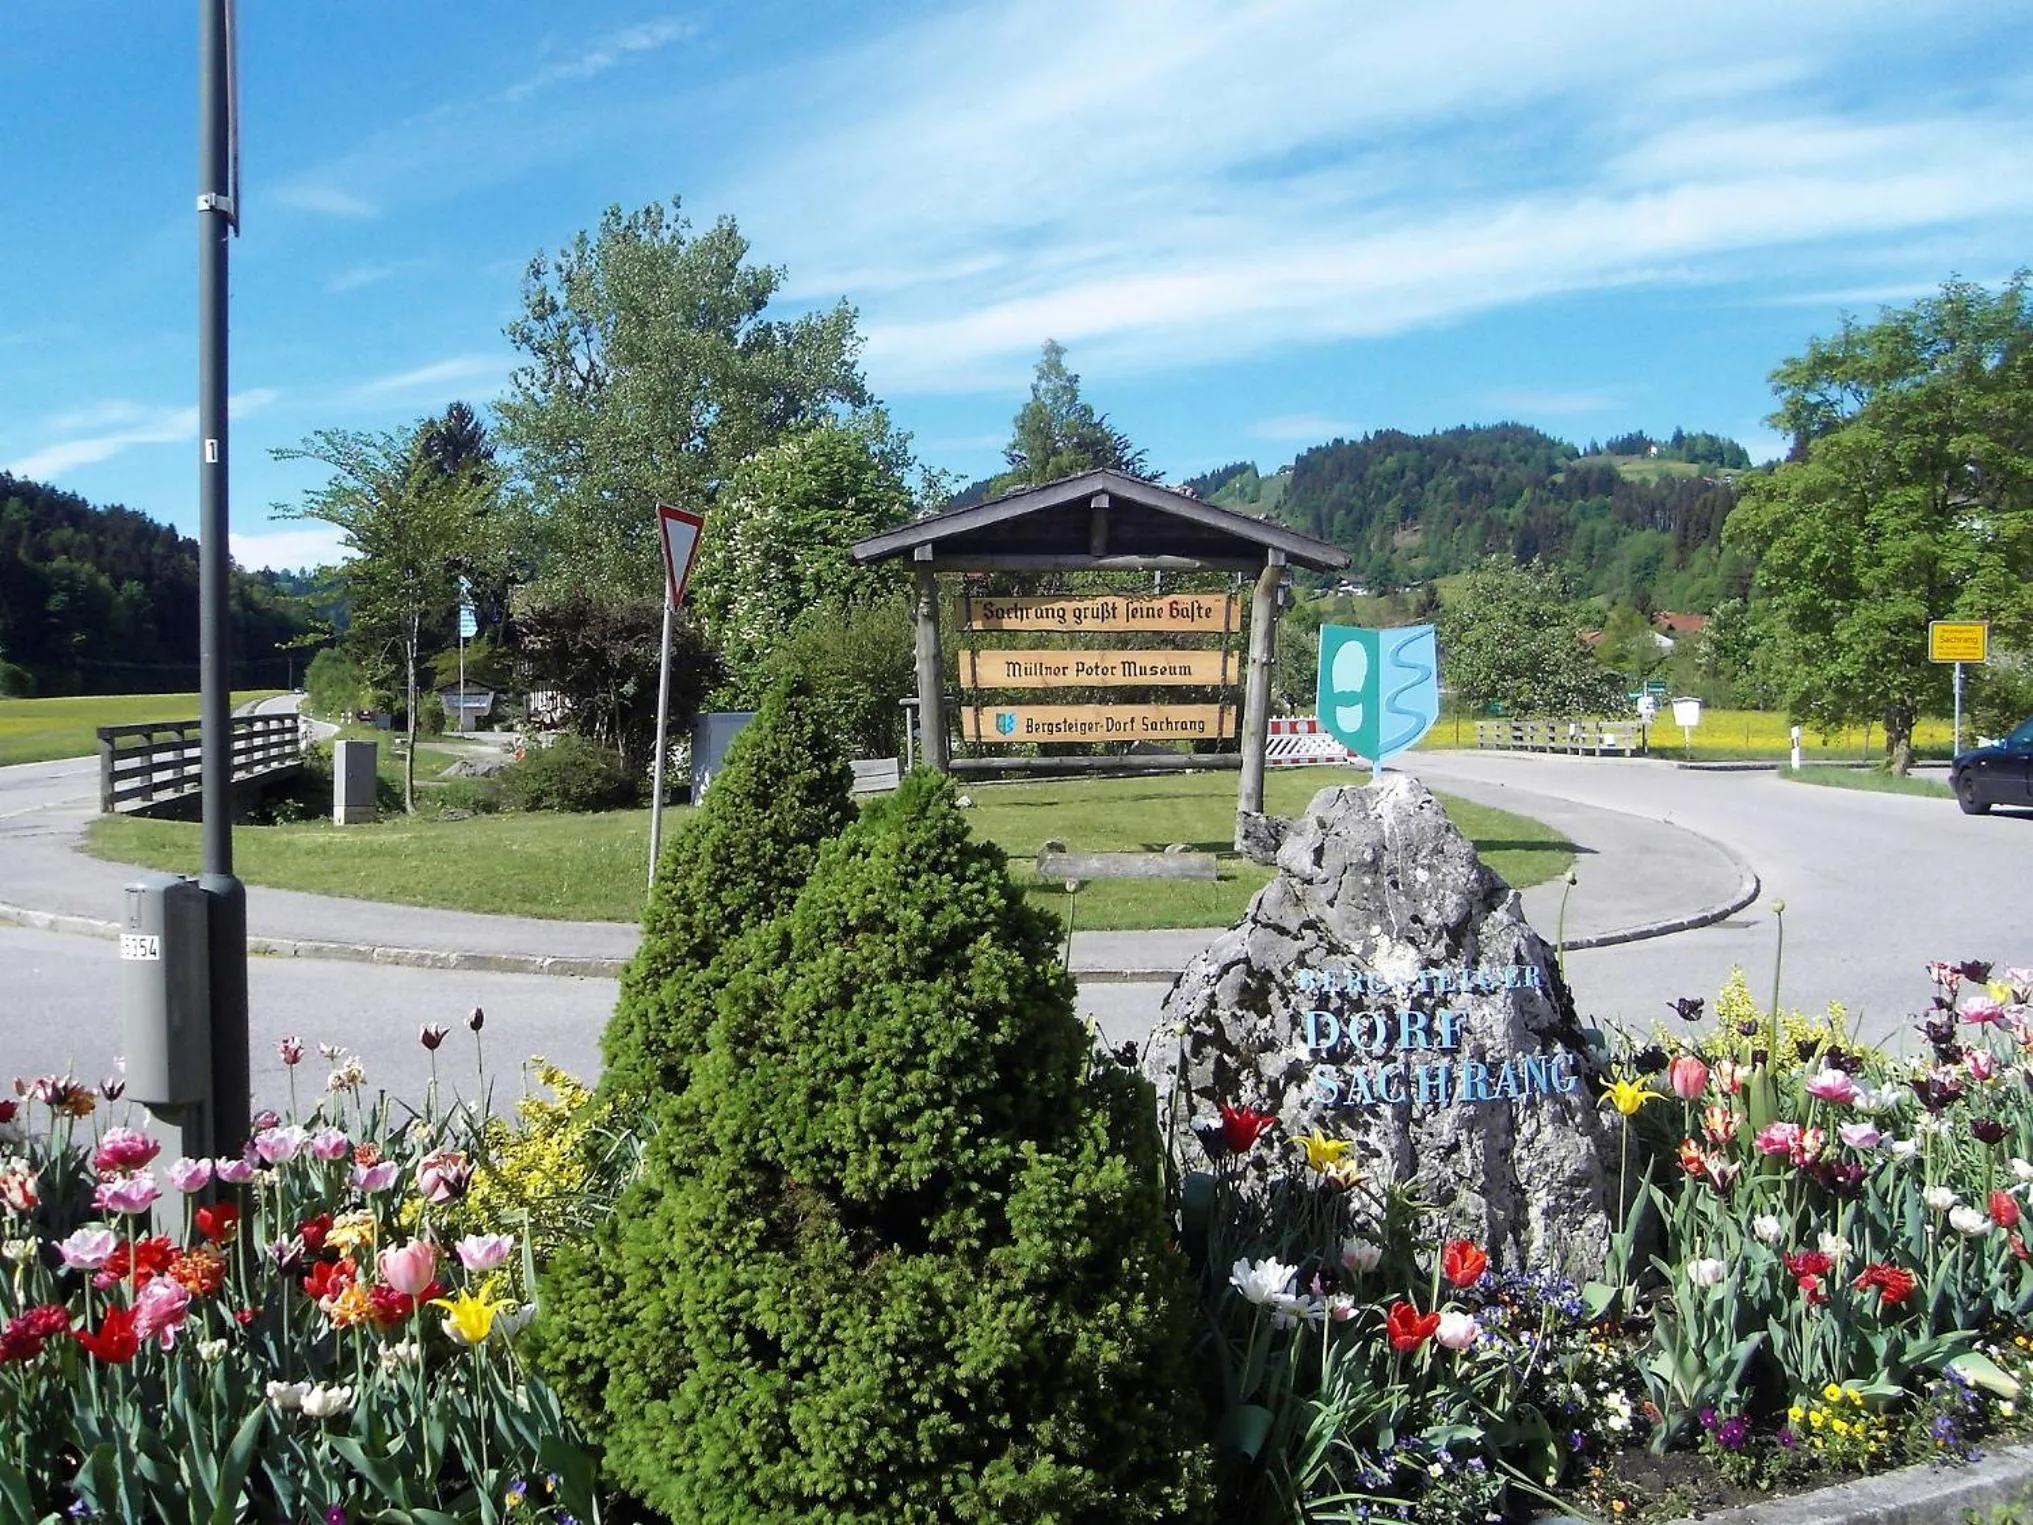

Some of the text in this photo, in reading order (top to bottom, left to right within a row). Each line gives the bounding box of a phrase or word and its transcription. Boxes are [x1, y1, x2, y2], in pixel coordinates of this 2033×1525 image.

[209, 441, 215, 460] 1
[1072, 601, 1117, 625] grüßt
[1940, 634, 1978, 646] Sachrang
[1005, 660, 1192, 677] Müllner Peter Museum
[1142, 716, 1205, 733] Sachrang
[1297, 964, 1544, 994] BERGTEIGER
[1302, 1009, 1470, 1051] DORF
[1313, 1053, 1580, 1106] SACHRANG
